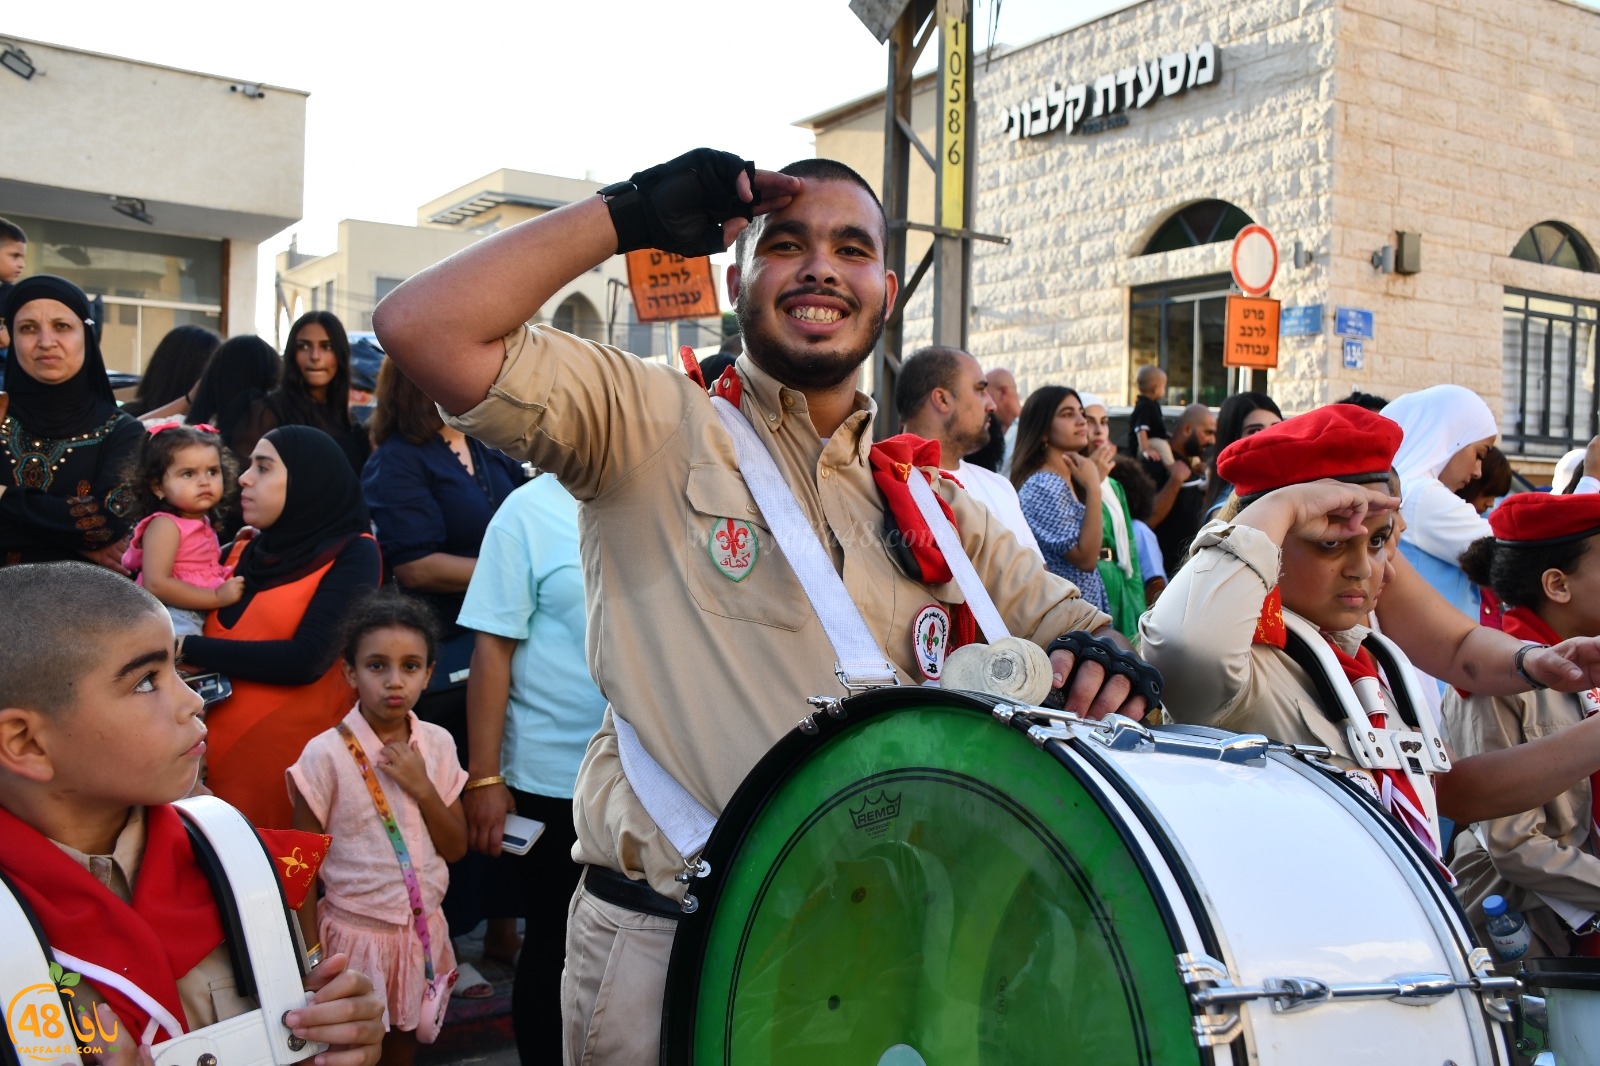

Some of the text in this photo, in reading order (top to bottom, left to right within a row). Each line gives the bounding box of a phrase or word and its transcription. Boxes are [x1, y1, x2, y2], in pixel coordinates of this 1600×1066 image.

[948, 22, 961, 165] 10586
[1001, 41, 1215, 142] מסעדת קלבוני
[648, 267, 692, 289] לרכב
[646, 291, 701, 309] עבודה
[1243, 308, 1264, 320] פרט
[1240, 325, 1266, 337] לרכב
[1235, 343, 1269, 355] עבודה
[857, 804, 896, 825] REMO
